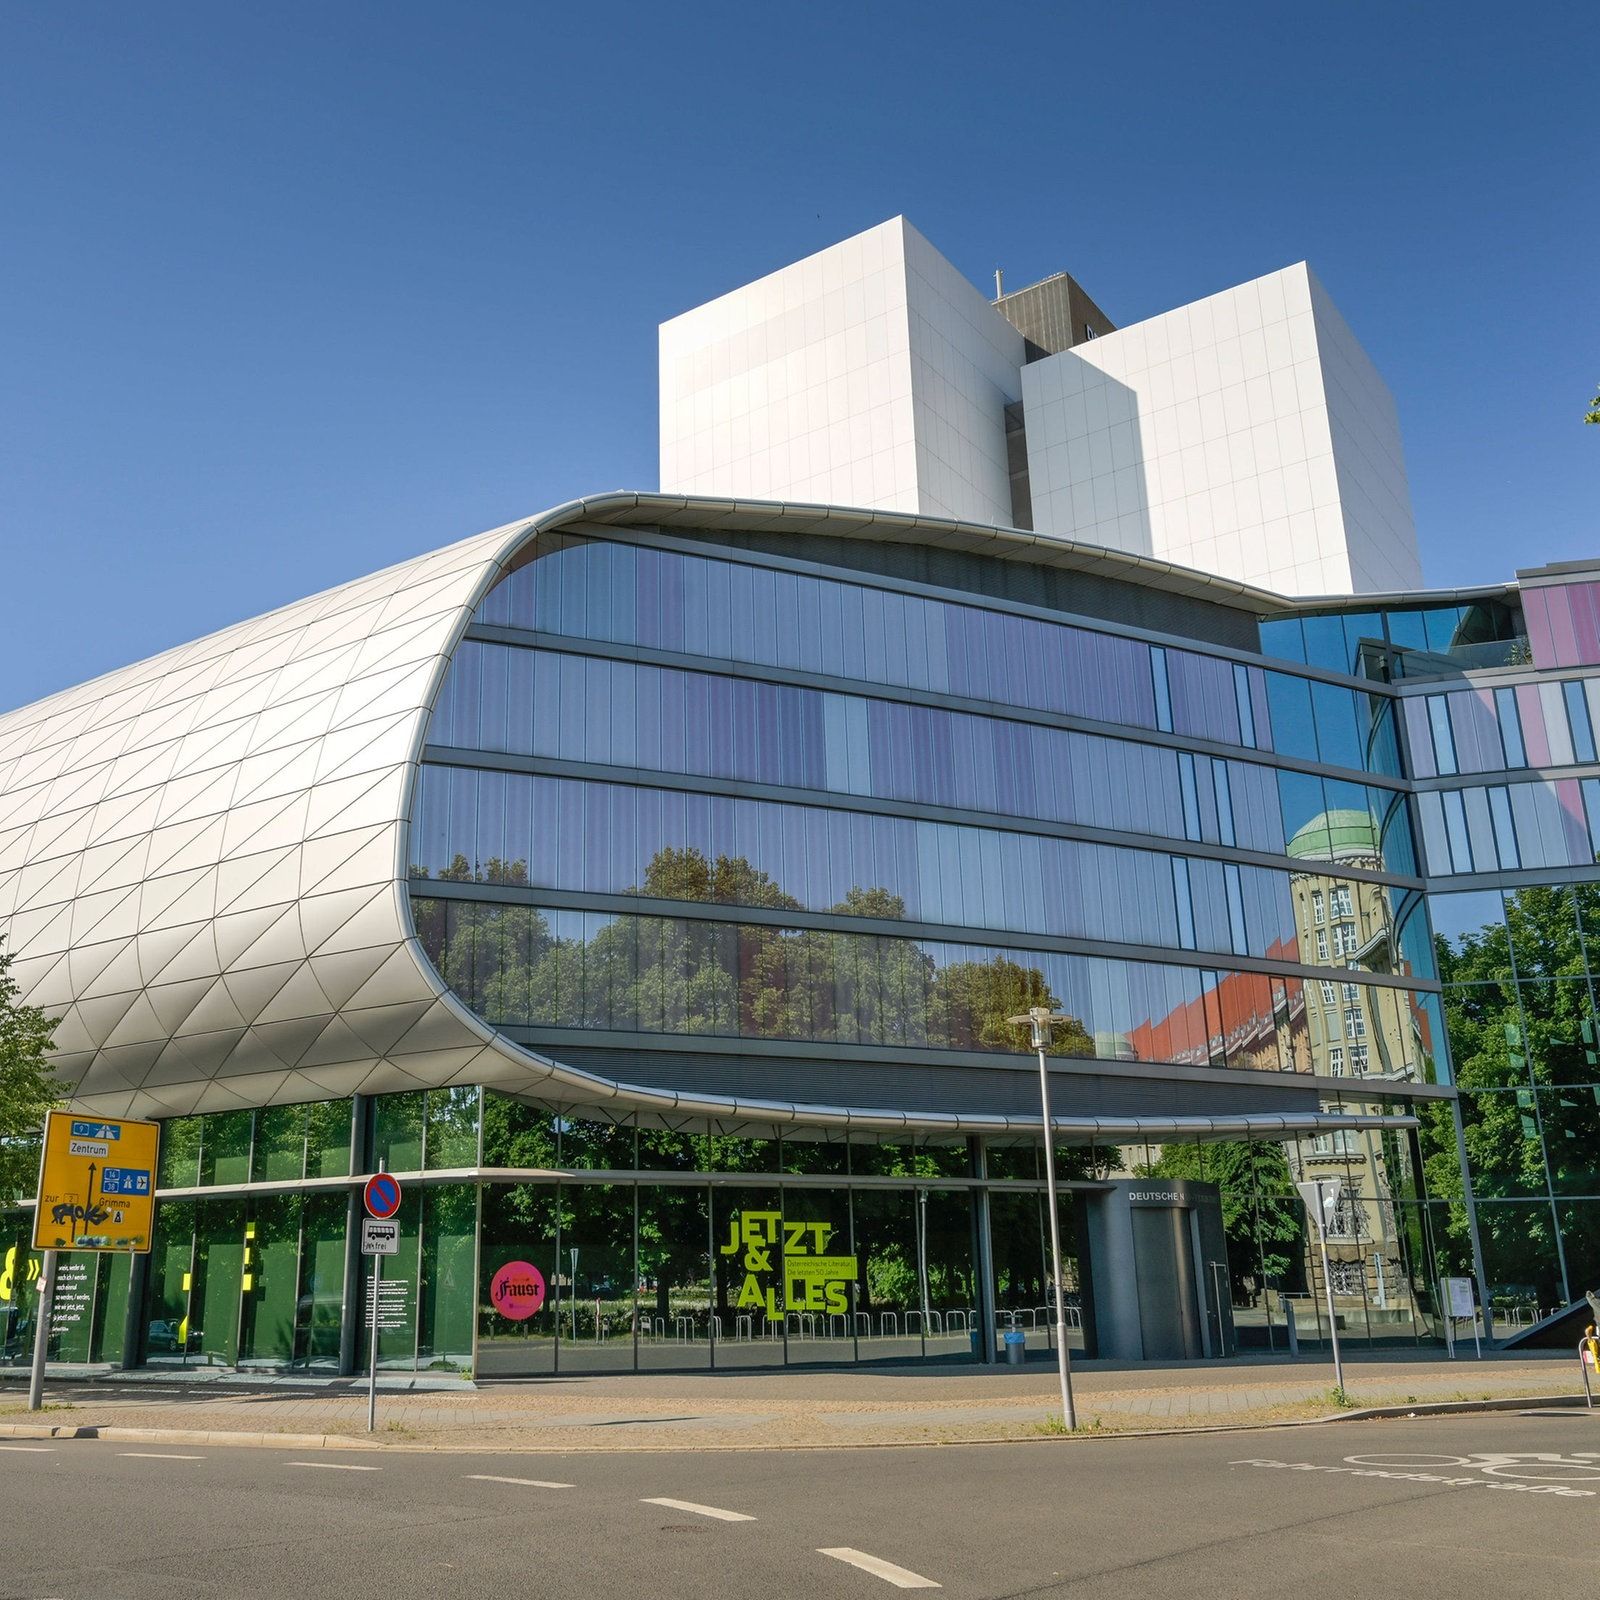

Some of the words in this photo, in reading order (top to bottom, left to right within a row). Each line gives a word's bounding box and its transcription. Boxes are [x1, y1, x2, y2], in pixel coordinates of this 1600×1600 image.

[71, 1142, 107, 1155] Zentrum
[44, 1194, 59, 1202] zur
[98, 1198, 130, 1208] Grimma
[720, 1211, 832, 1254] JETZT
[744, 1238, 774, 1272] &
[495, 1277, 540, 1301] Faust
[737, 1274, 848, 1320] ALLES
[1228, 1459, 1596, 1497] Fahrradstraße
